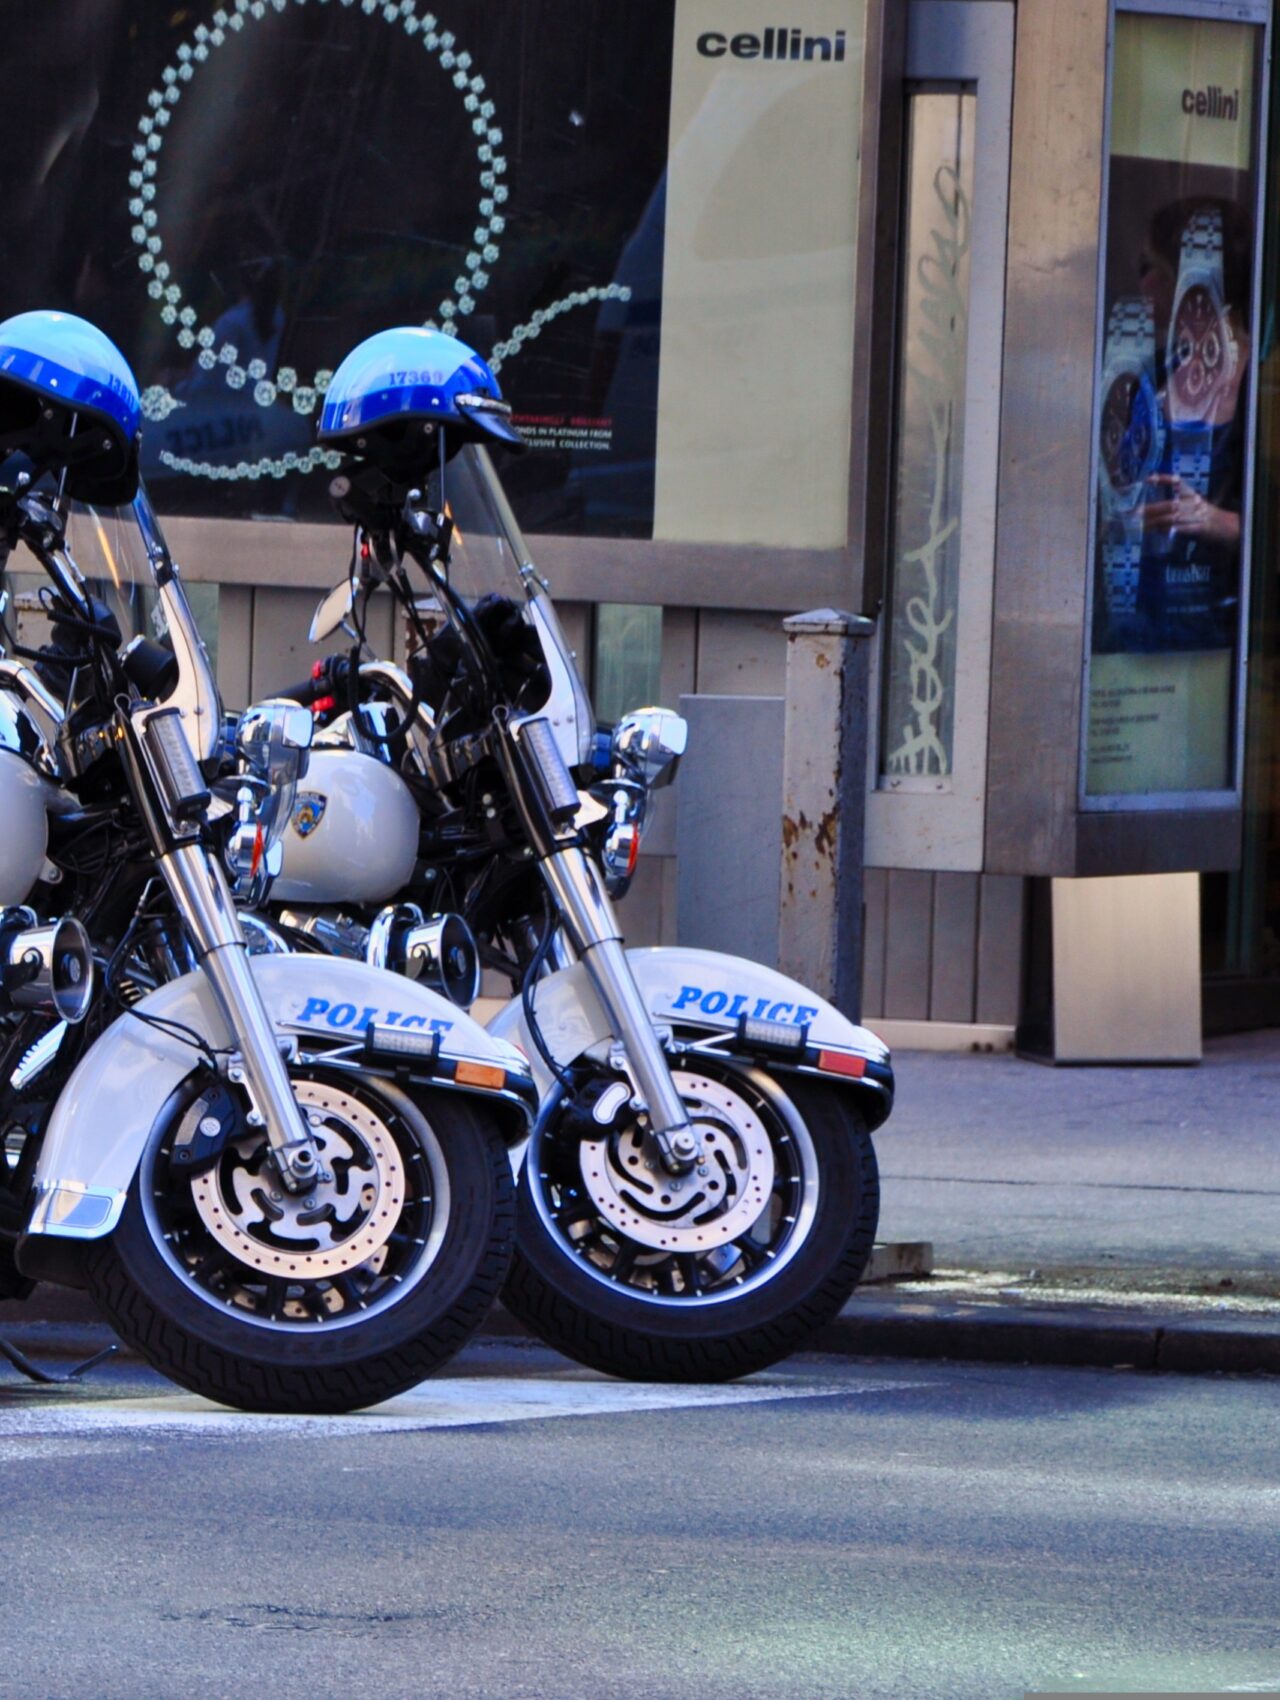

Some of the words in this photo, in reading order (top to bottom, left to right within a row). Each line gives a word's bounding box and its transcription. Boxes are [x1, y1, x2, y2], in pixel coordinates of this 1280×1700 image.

[696, 27, 846, 62] cellini
[1181, 85, 1239, 122] cellini
[549, 427, 588, 439] PLATINUM
[672, 985, 819, 1030] POLICE
